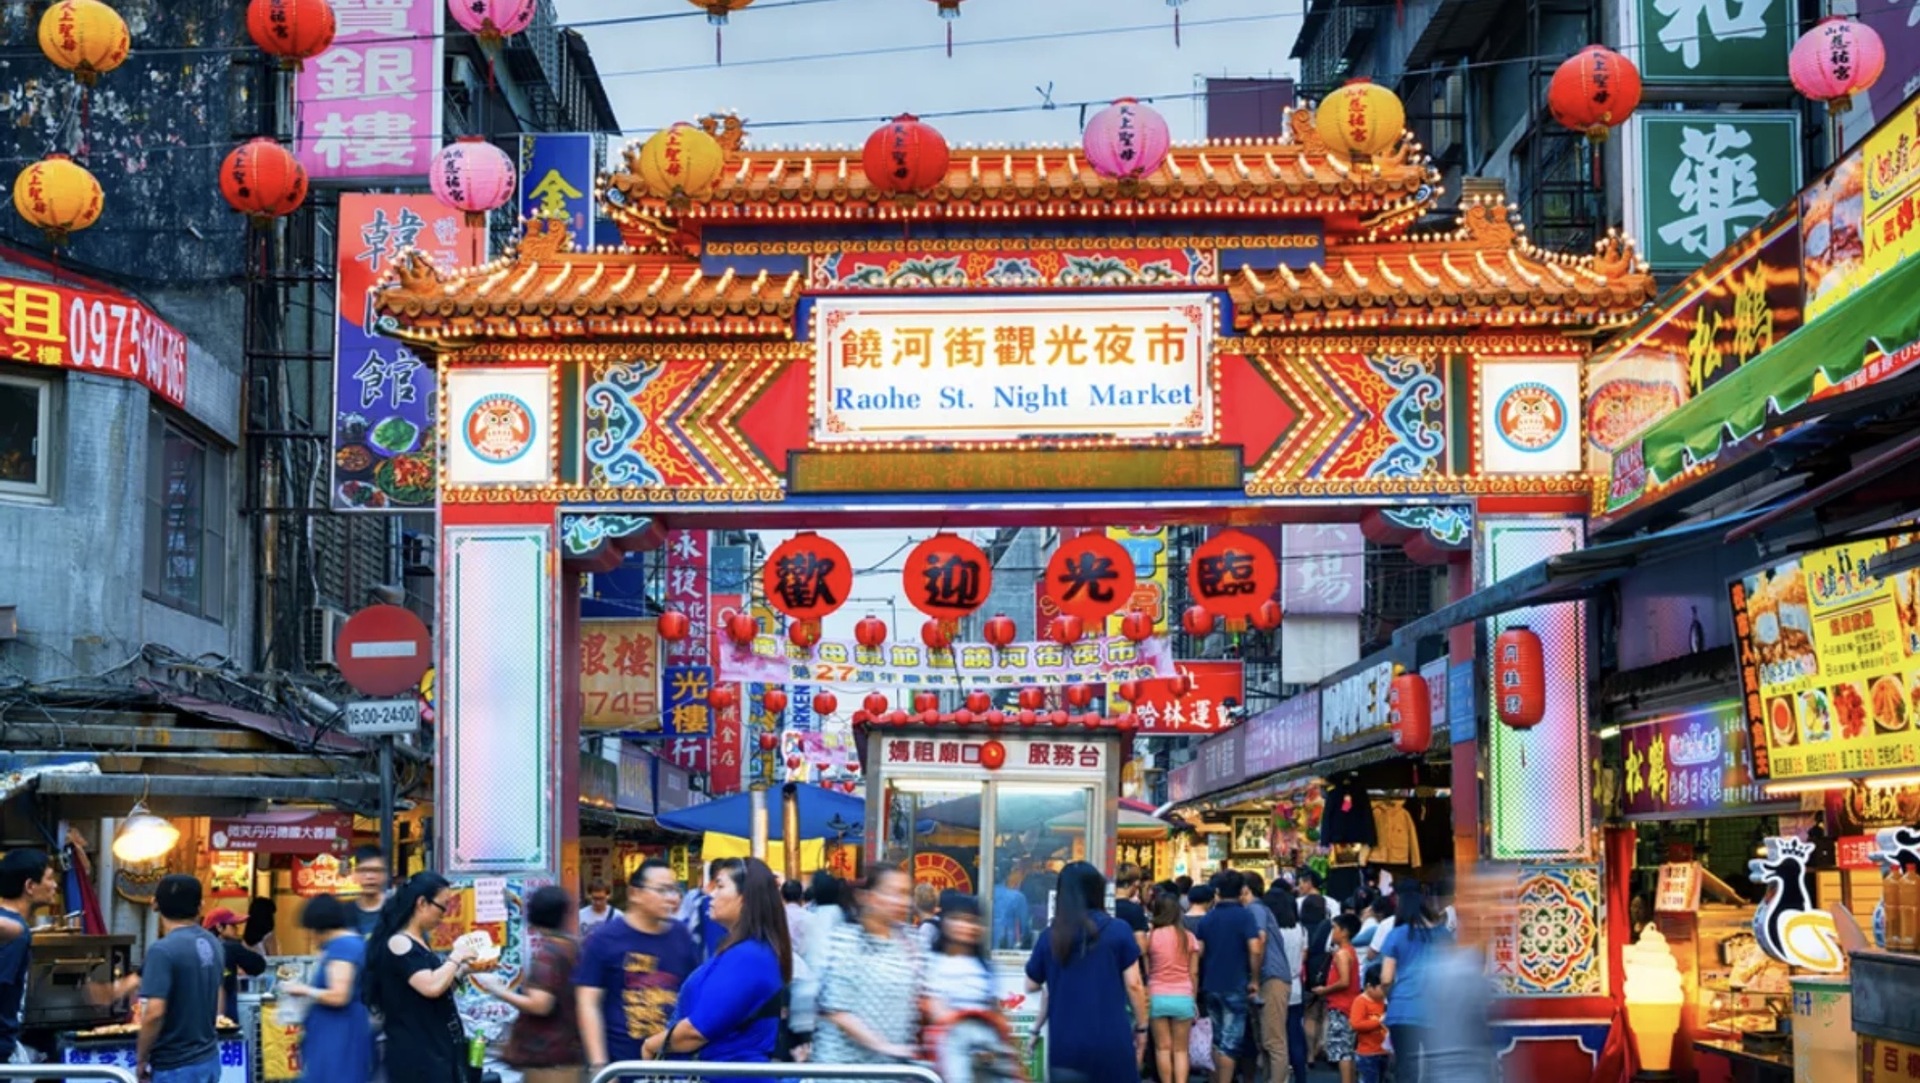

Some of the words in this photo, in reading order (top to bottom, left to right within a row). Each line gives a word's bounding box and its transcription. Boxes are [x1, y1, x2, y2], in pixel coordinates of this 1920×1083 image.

[1830, 34, 1852, 81] 慈祐宮
[1117, 104, 1136, 162] 天上聖母
[353, 207, 425, 408] 韓館
[839, 322, 1189, 369] 饒河街觀光夜市
[834, 386, 922, 411] Raohe
[939, 385, 974, 410] St.
[993, 384, 1069, 413] Night
[1089, 382, 1193, 408] Market
[923, 553, 983, 610] 迎
[1058, 551, 1120, 603] 光
[1197, 550, 1257, 598] 臨
[348, 705, 415, 725] 16:00-24:00
[888, 740, 980, 765] 媽祖廟口
[1028, 743, 1101, 767] 服務台
[221, 1042, 243, 1066] 胡
